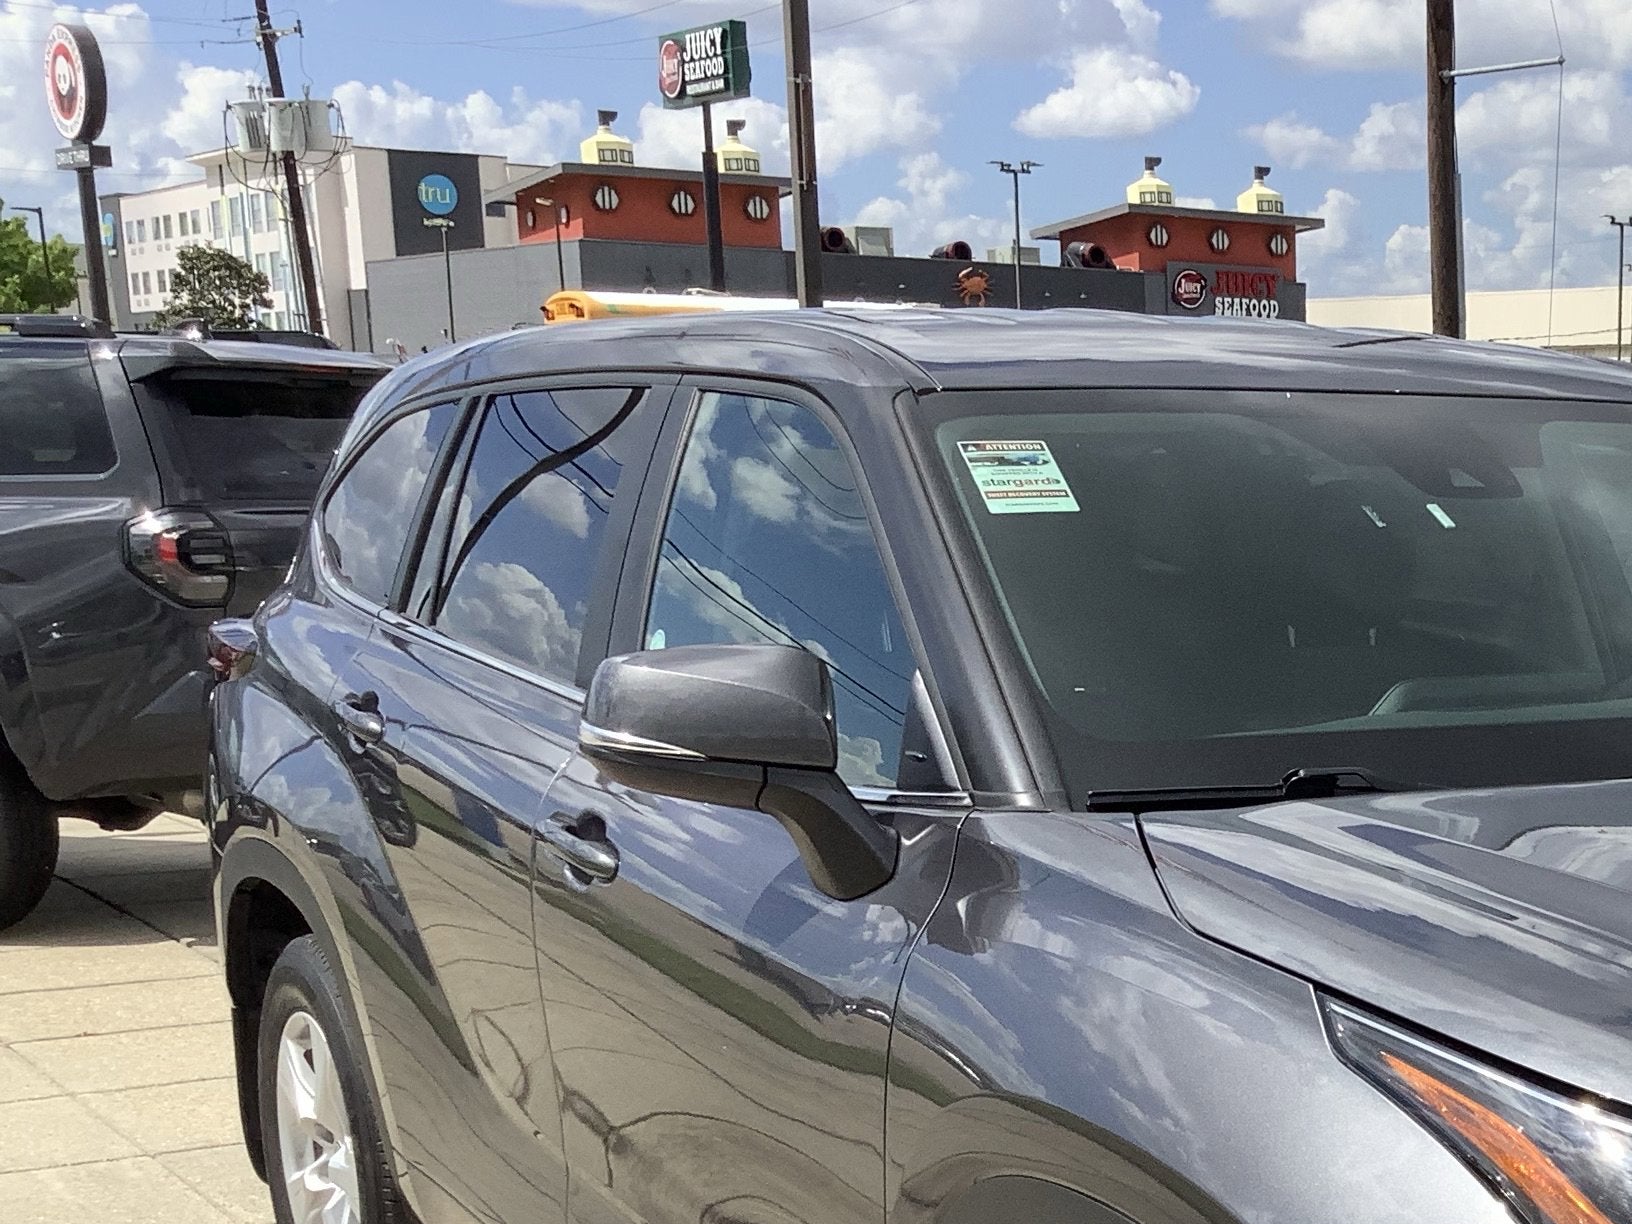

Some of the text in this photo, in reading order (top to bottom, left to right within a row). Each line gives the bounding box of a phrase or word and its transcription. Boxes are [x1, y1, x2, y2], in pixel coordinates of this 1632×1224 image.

[683, 26, 722, 61] JUICY
[684, 56, 724, 82] SEAFOOD
[418, 182, 450, 203] tru
[1210, 270, 1277, 298] JUICY
[1215, 296, 1279, 319] SEAFOOD
[985, 443, 1041, 451] ATTENTION
